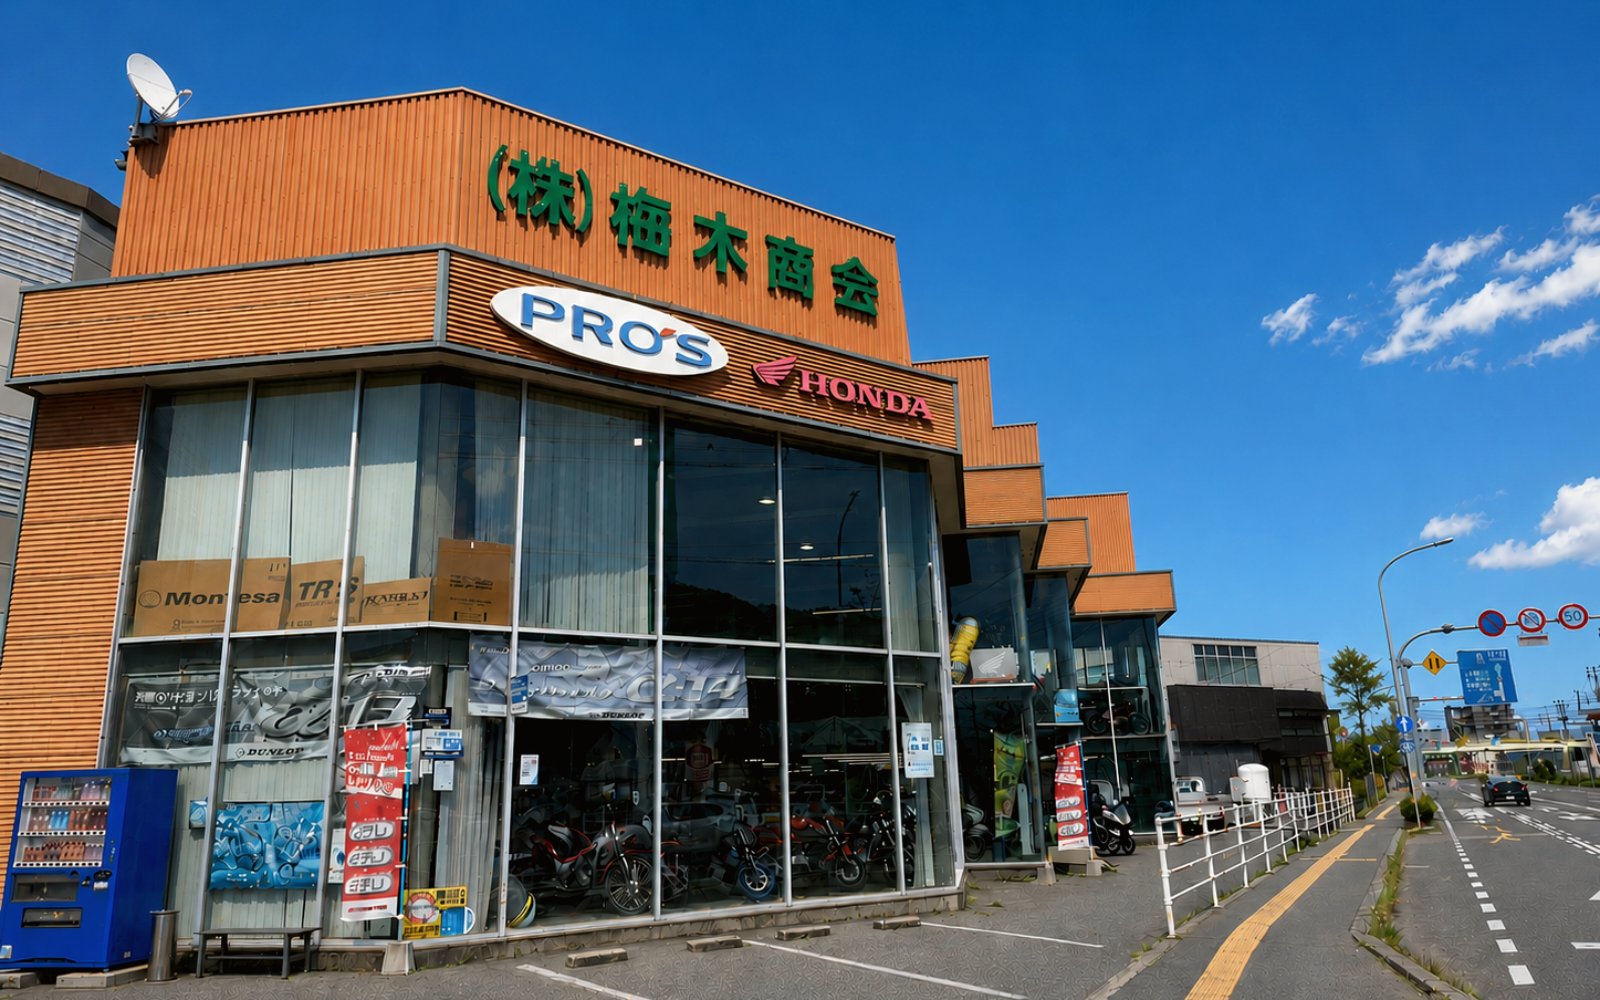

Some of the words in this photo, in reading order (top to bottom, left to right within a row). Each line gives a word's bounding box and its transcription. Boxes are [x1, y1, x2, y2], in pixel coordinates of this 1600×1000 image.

[488, 144, 878, 316] (株)梅木商会
[521, 292, 713, 367] PRO'S
[801, 370, 934, 420] HONDA
[164, 591, 281, 606] Monesa
[1564, 610, 1582, 622] 50
[601, 711, 645, 719] DUNLOP
[246, 747, 304, 756] DUNLOP
